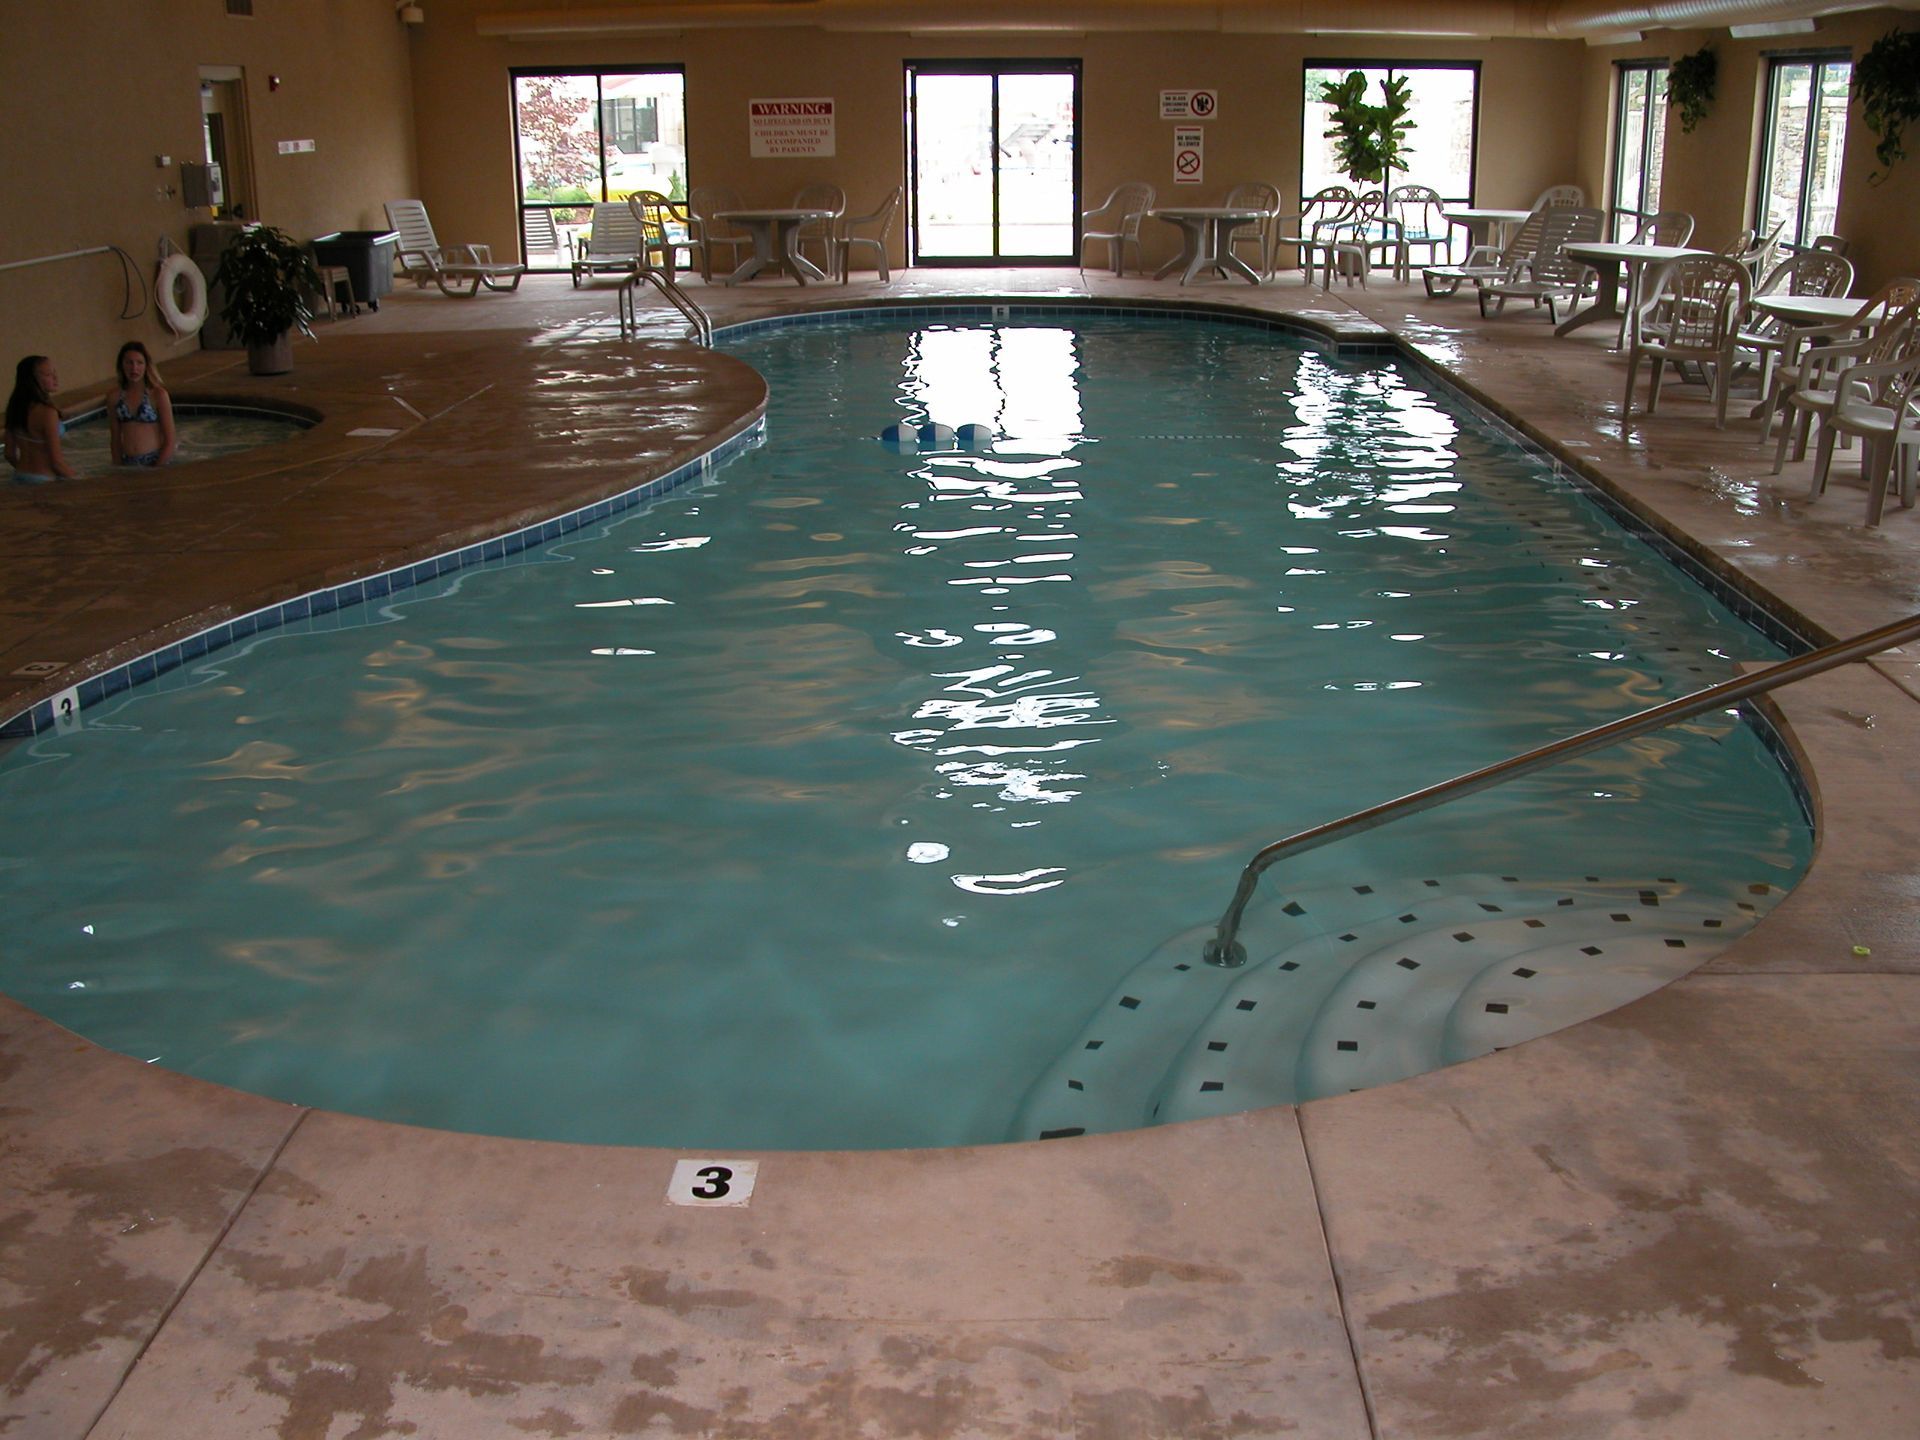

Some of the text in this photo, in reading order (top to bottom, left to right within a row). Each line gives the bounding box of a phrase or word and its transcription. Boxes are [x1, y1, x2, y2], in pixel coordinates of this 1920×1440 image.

[758, 103, 826, 114] WARNING
[796, 128, 817, 136] MUST
[819, 128, 828, 136] BE
[691, 1166, 733, 1199] 3
